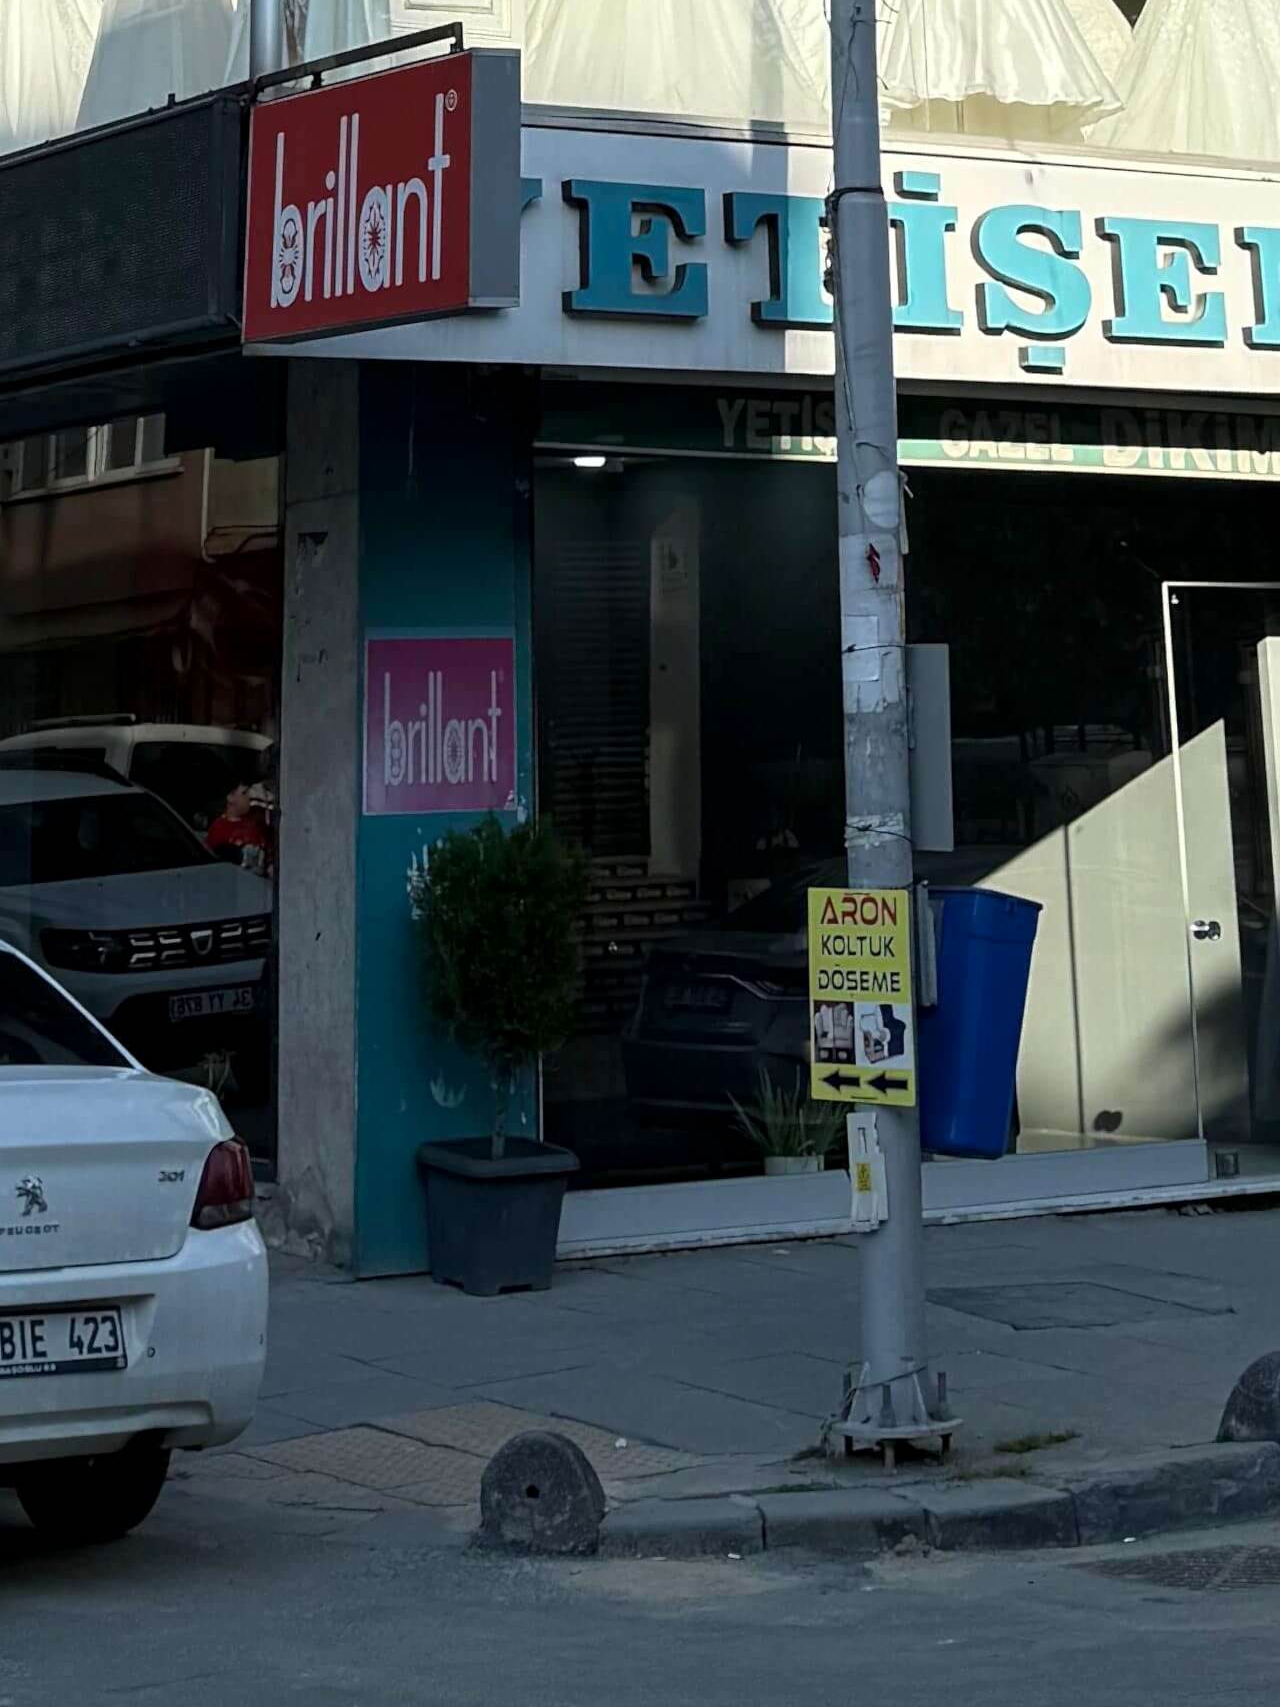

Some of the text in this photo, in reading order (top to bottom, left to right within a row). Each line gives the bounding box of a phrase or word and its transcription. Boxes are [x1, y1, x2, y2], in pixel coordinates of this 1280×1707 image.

[271, 92, 451, 309] brillant
[715, 393, 835, 457] YETİŞ
[938, 407, 1074, 462] GAZEL
[384, 669, 502, 786] brillant
[821, 895, 898, 926] ARON
[821, 934, 896, 958] KOLTUK
[158, 1170, 185, 1183] 301
[0, 1319, 48, 1361] BIE
[70, 1315, 120, 1356] 423
